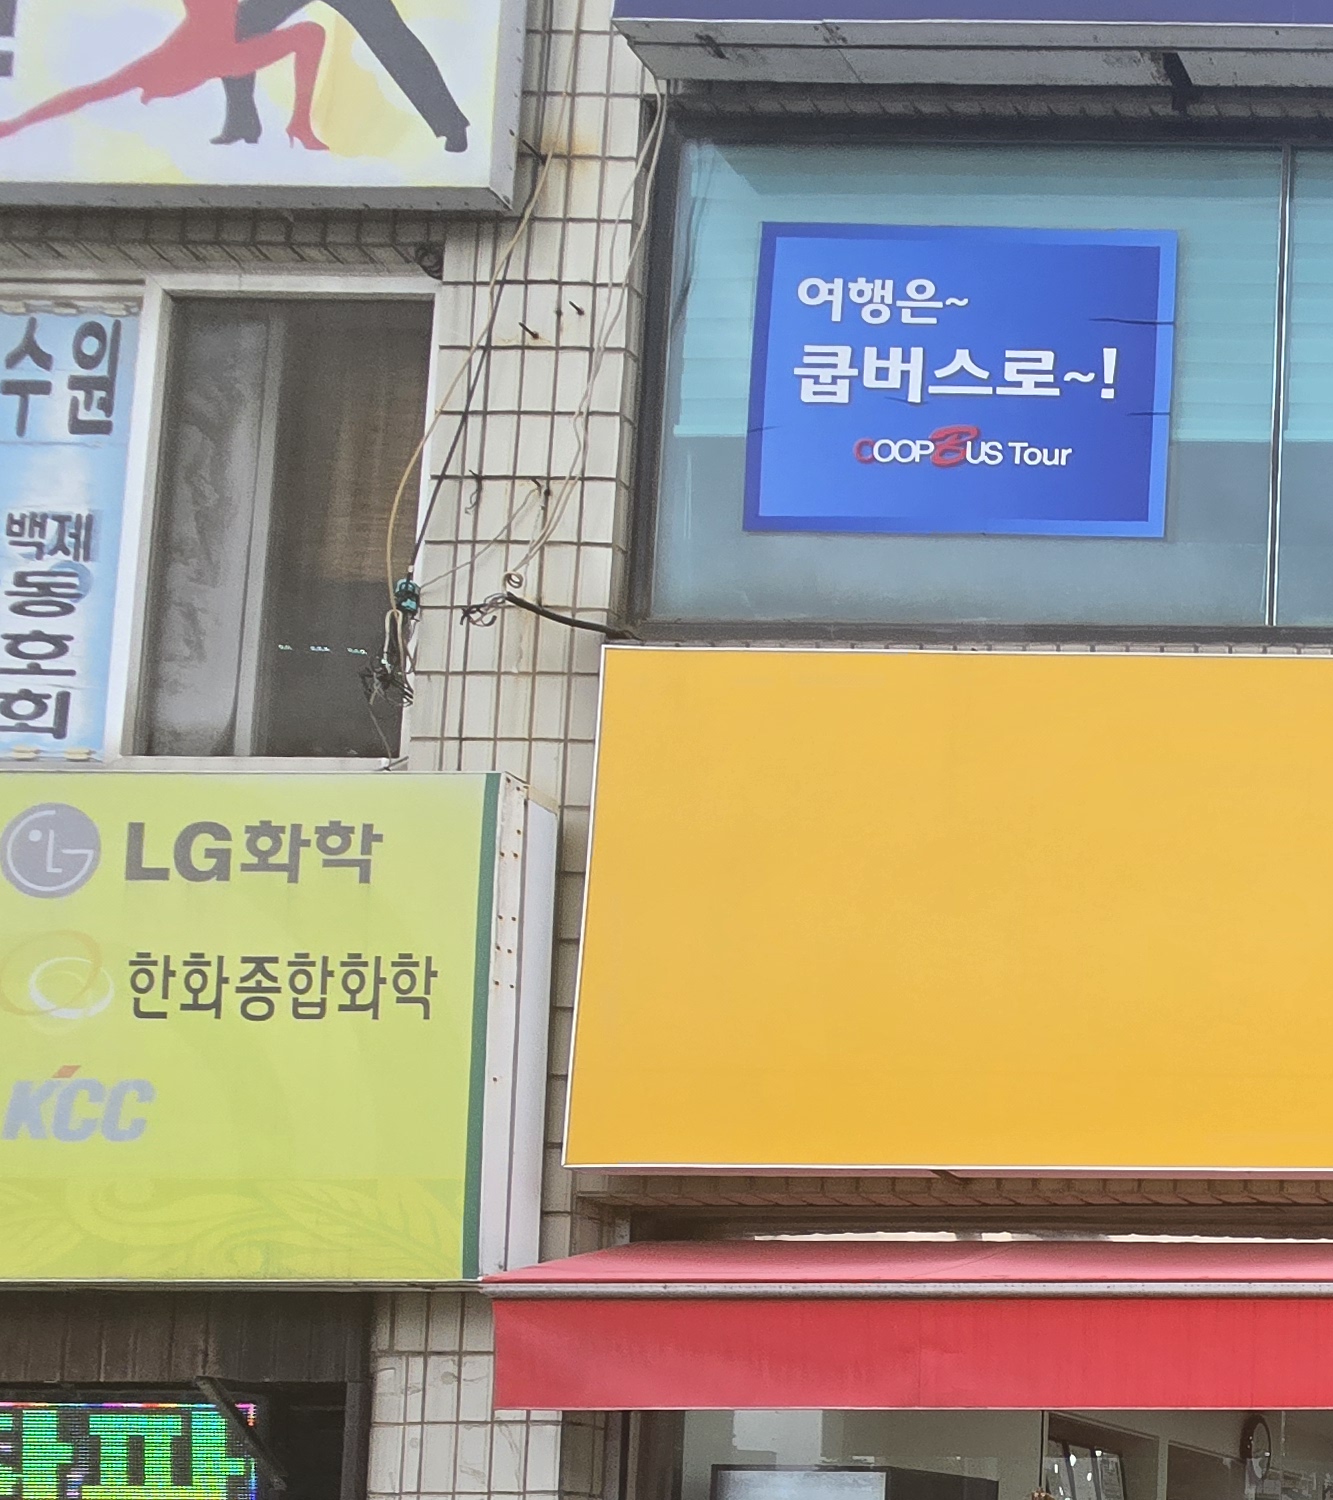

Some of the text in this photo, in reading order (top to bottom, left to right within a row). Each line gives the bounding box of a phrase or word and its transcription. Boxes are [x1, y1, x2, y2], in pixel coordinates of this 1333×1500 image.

[797, 277, 969, 325] 여행은~
[793, 344, 1117, 404] 쿱버스로~!
[1008, 442, 1073, 467] Tour
[124, 820, 384, 884] LG화학
[129, 951, 439, 1021] 한화종합화학
[1, 1065, 156, 1143] KCC
